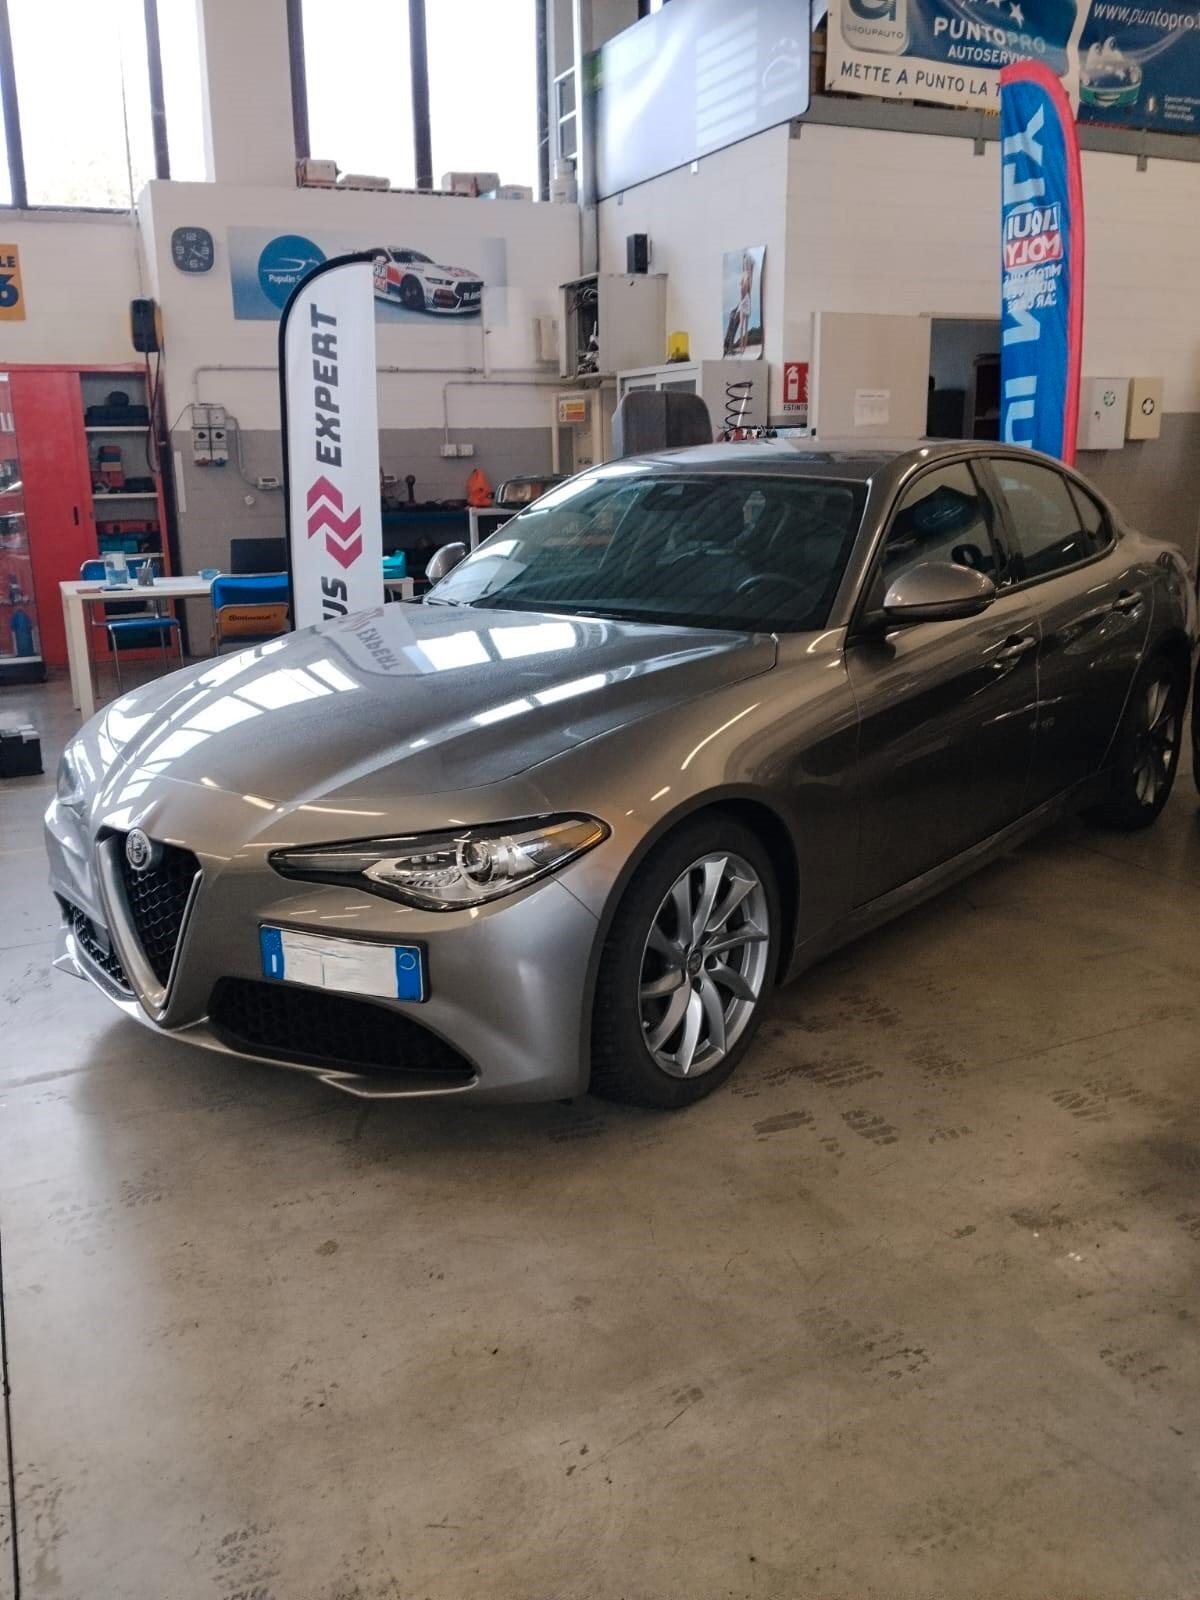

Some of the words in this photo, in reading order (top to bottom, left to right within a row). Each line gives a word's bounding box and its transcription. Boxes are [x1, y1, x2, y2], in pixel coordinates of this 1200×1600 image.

[933, 17, 1047, 54] PUNTOPRO
[841, 61, 891, 83] METTE
[896, 69, 908, 85] A
[915, 71, 965, 92] PUNTO
[969, 79, 988, 97] LA
[310, 303, 343, 468] EXPERT
